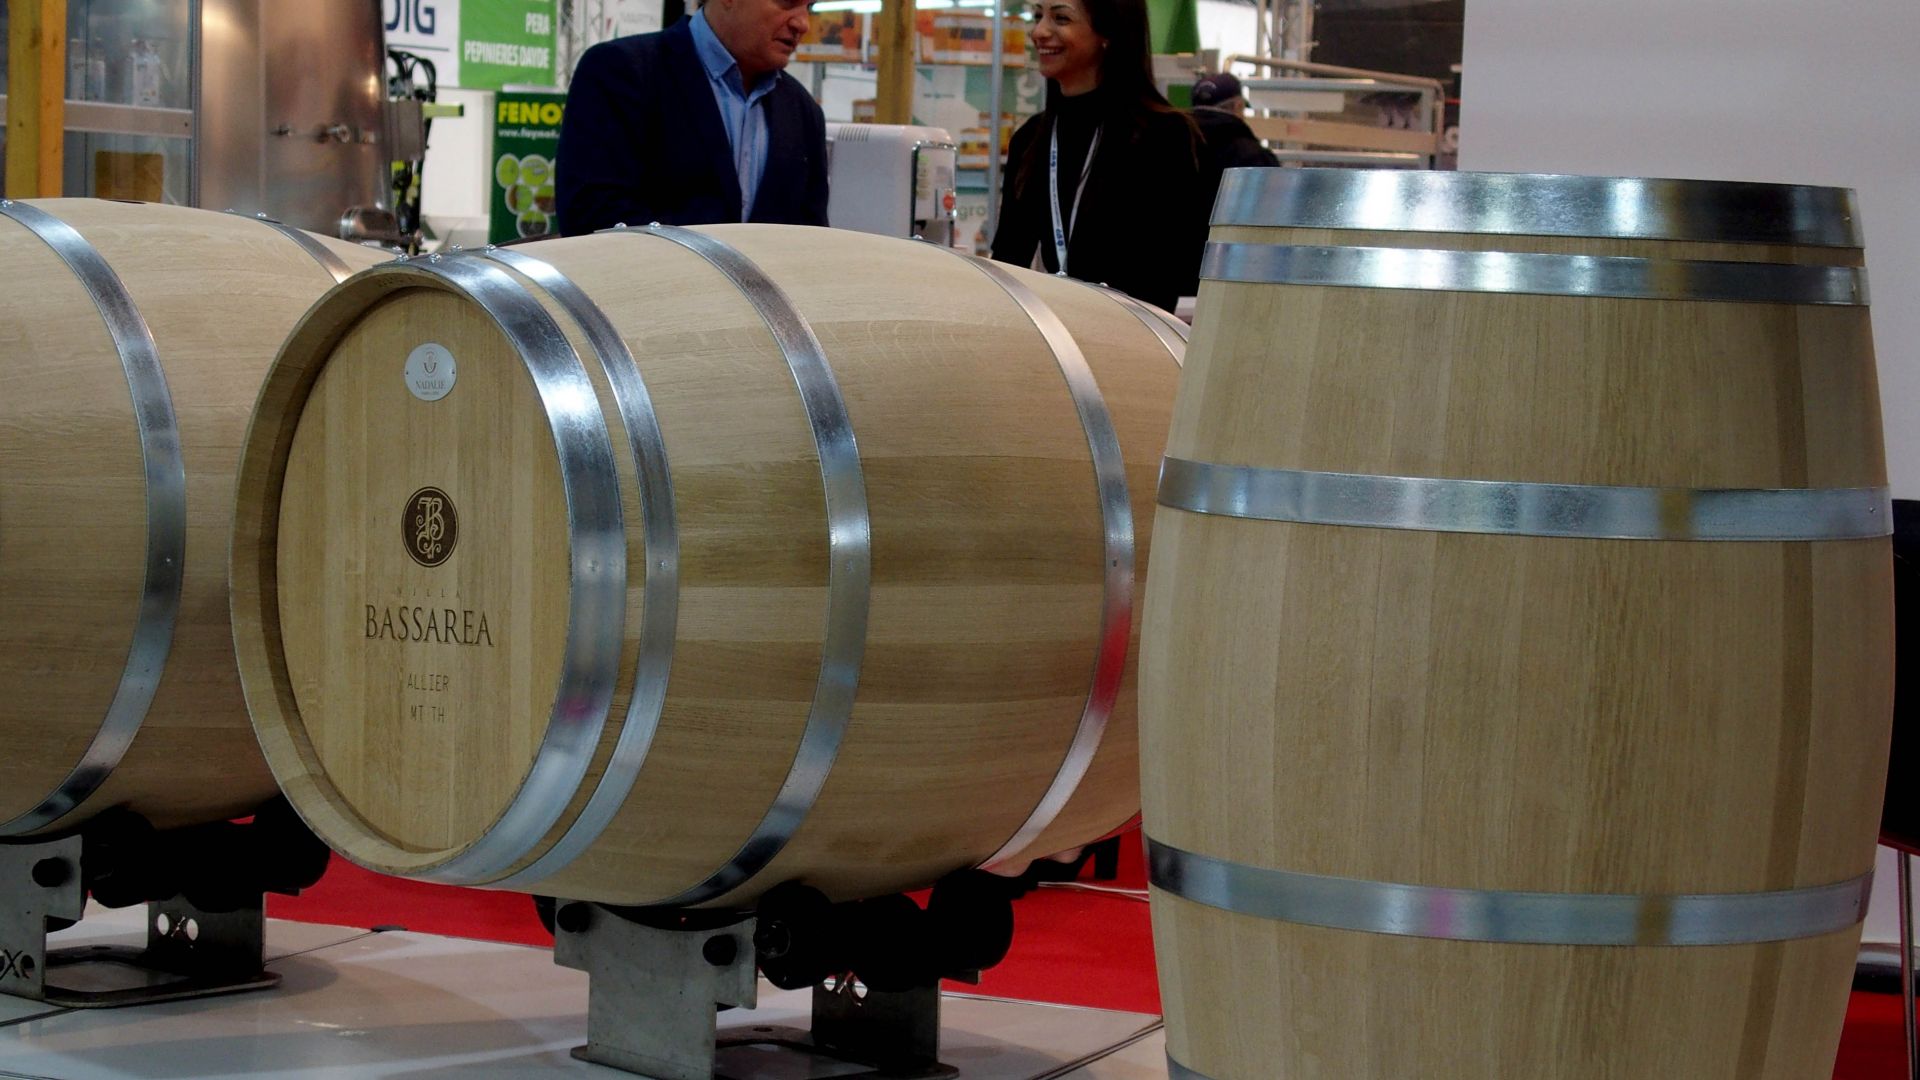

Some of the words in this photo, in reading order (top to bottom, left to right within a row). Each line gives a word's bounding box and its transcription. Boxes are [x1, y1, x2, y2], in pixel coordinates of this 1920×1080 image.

[525, 12, 549, 35] PERA
[464, 40, 518, 67] PEPINIERES
[365, 604, 495, 648] BASSAREA
[407, 672, 449, 692] ALLIER
[410, 704, 423, 721] MT
[431, 706, 445, 724] TH
